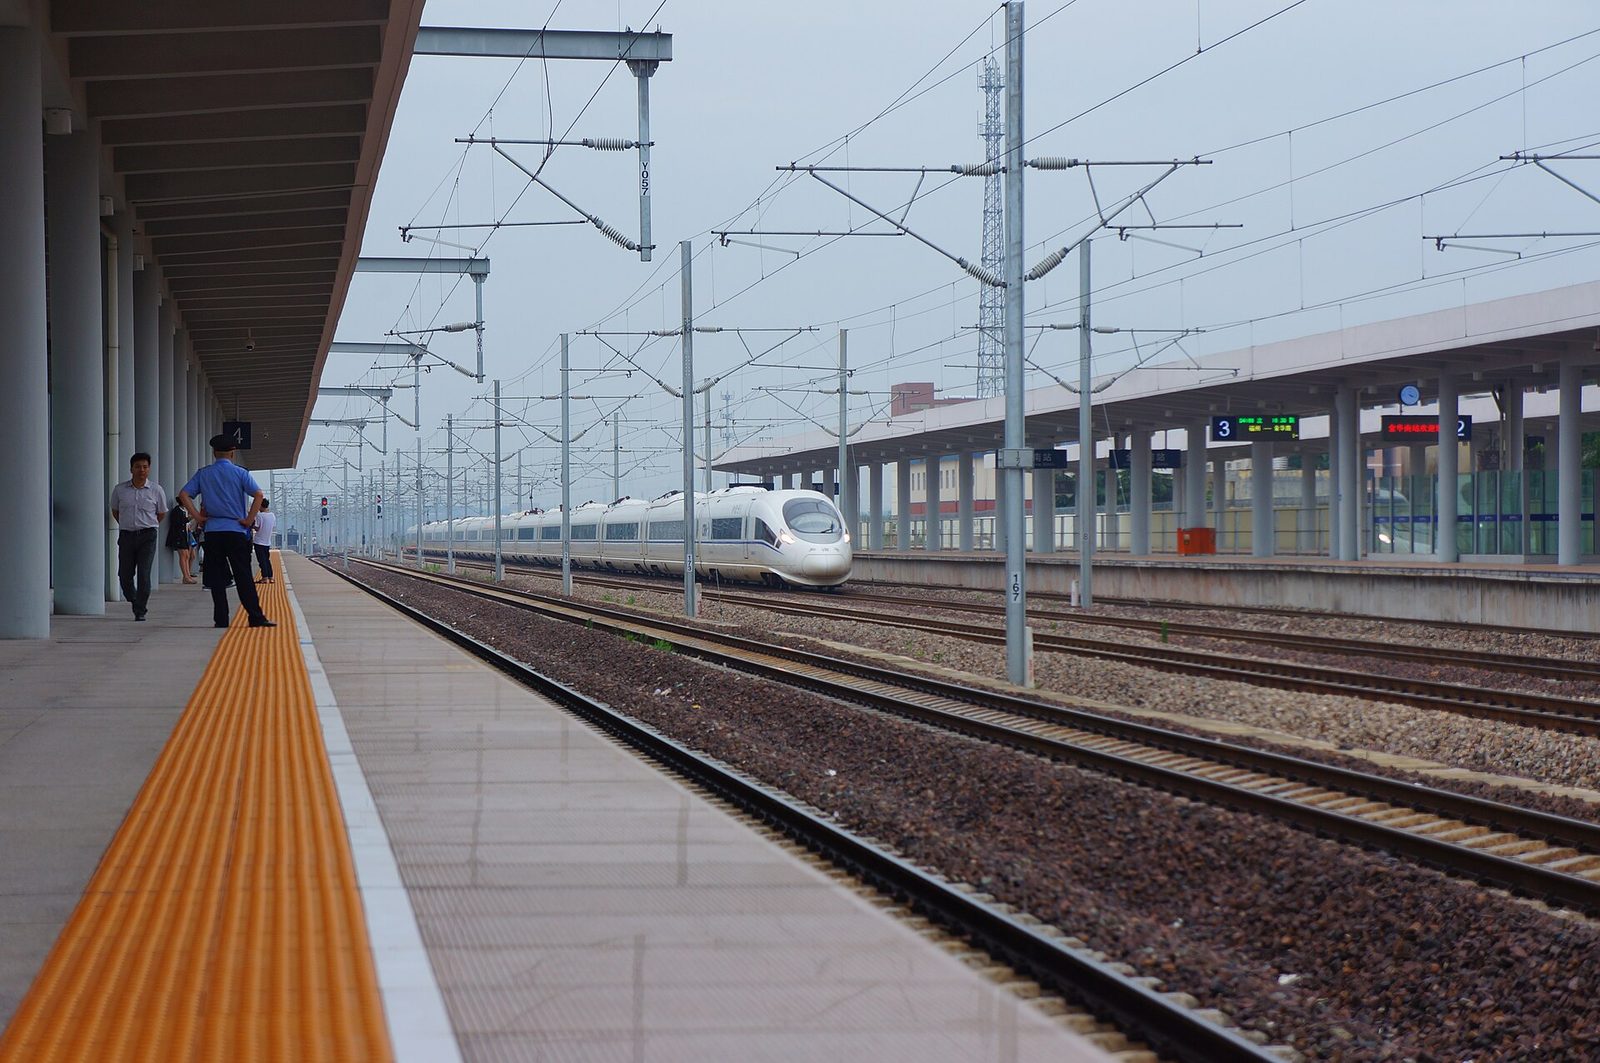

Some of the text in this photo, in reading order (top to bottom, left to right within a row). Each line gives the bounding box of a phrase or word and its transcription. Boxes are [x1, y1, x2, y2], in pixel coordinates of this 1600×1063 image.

[641, 162, 649, 196] Y057
[232, 427, 244, 445] 4
[1218, 420, 1231, 437] 3
[1457, 420, 1465, 437] 2
[1012, 573, 1020, 602] 167
